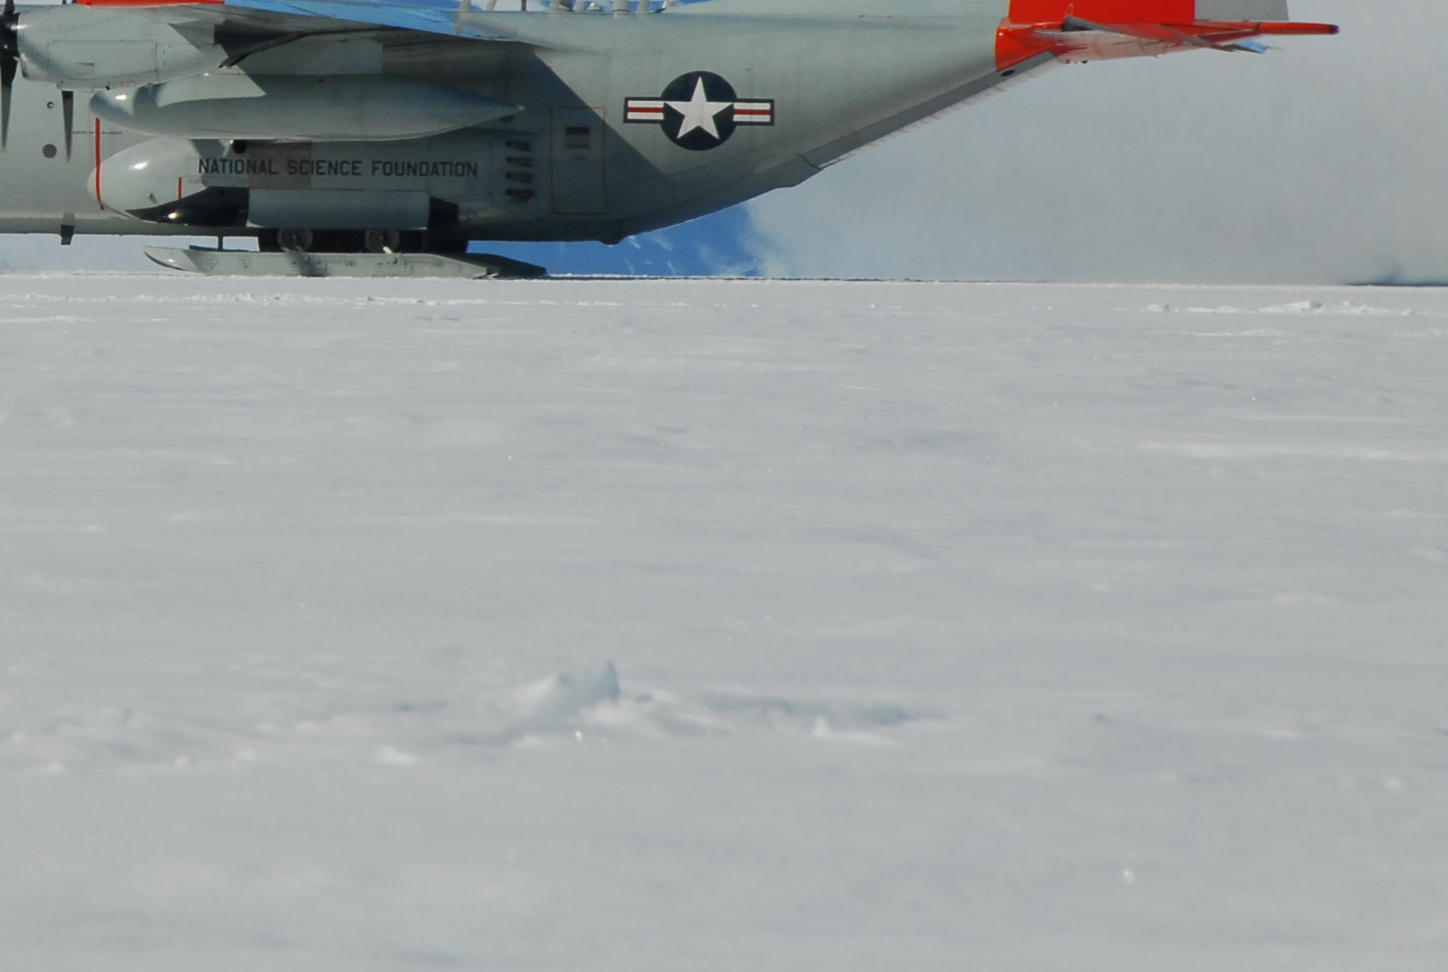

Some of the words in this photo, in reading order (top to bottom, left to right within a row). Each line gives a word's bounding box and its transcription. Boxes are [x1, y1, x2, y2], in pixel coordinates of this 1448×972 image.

[198, 158, 279, 175] NATIONAL
[287, 159, 363, 176] SCIENCE
[372, 161, 478, 177] FOUNDATION
